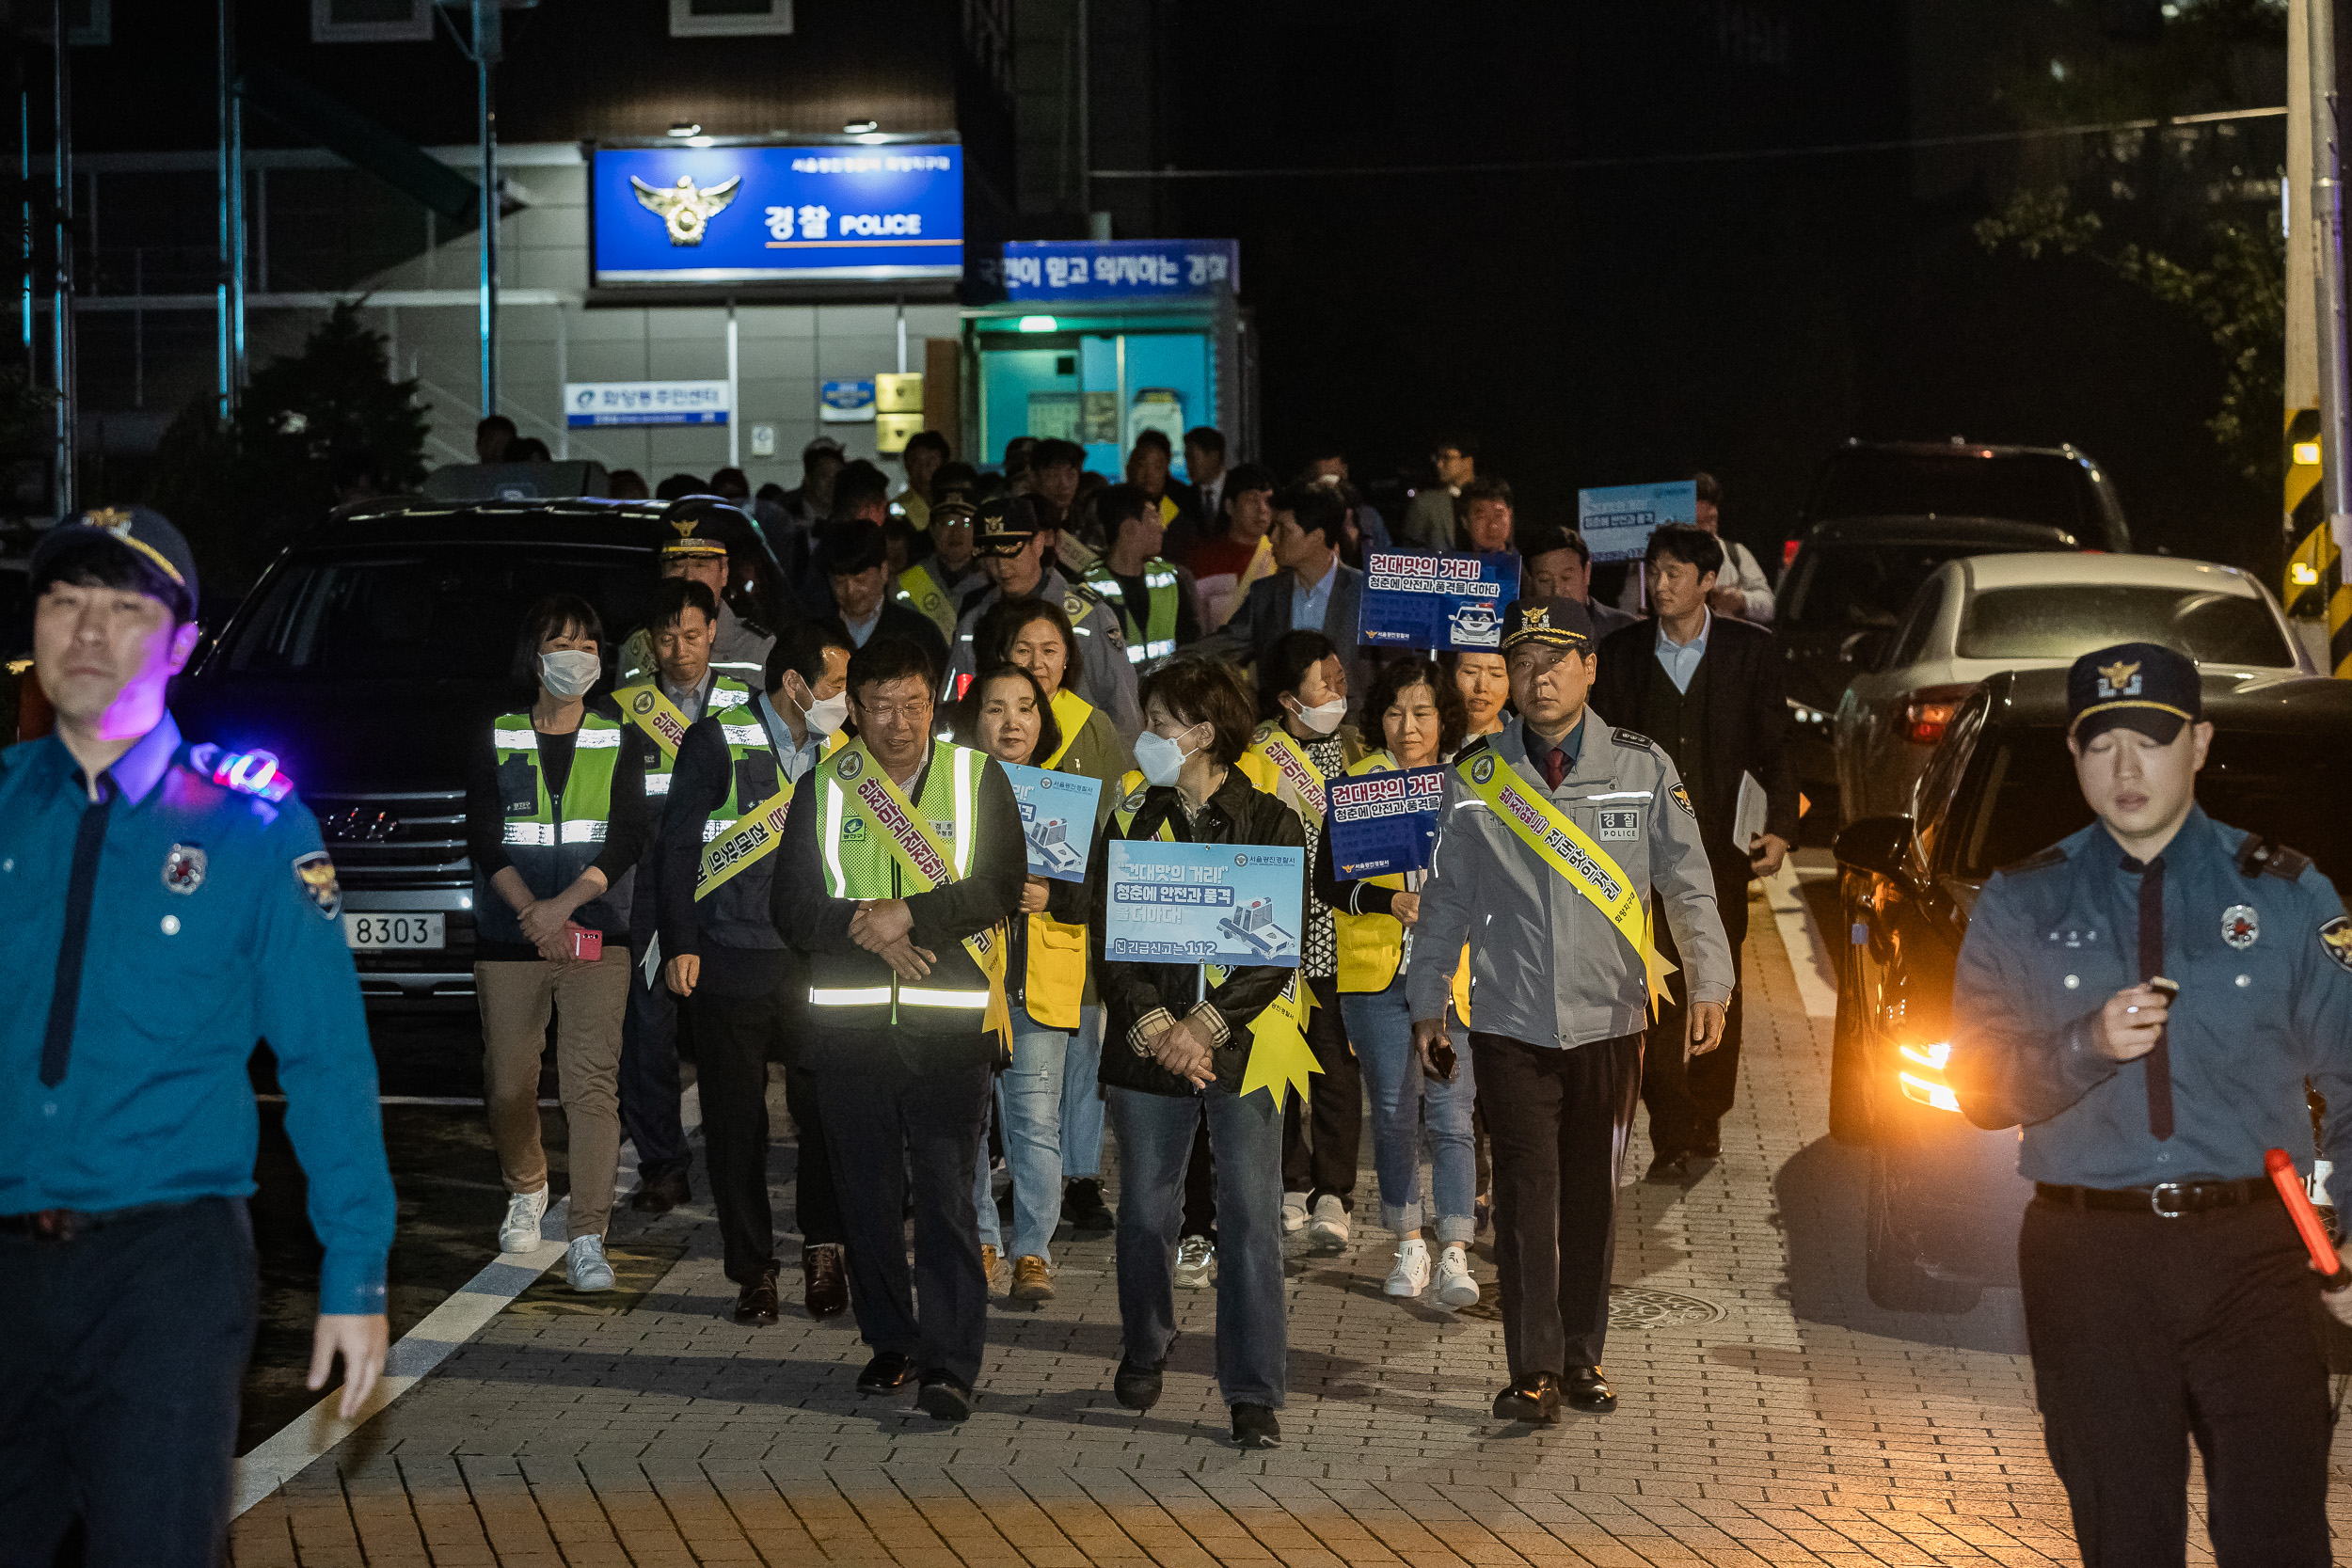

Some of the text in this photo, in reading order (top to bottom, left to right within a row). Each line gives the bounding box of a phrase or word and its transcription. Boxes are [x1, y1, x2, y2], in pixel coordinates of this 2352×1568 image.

[765, 204, 922, 240] 경찰 POLICE
[1044, 256, 1089, 288] 믿고
[1370, 554, 1481, 580] 건대맛의 거리!
[1369, 576, 1501, 597] 청춘에 안전과 품격을 더하다
[1332, 778, 1406, 806] 건대맛의
[1335, 796, 1440, 822] 청춘에 안전과 품격을
[1497, 784, 1549, 836] 범죄없는
[856, 777, 947, 882] 안전하고 건전한
[1249, 855, 1295, 863] 서울광진경찰서
[1116, 883, 1231, 905] 청춘에 안전과 품격
[1116, 905, 1183, 925] 을 더하다!
[357, 918, 428, 944] 8303
